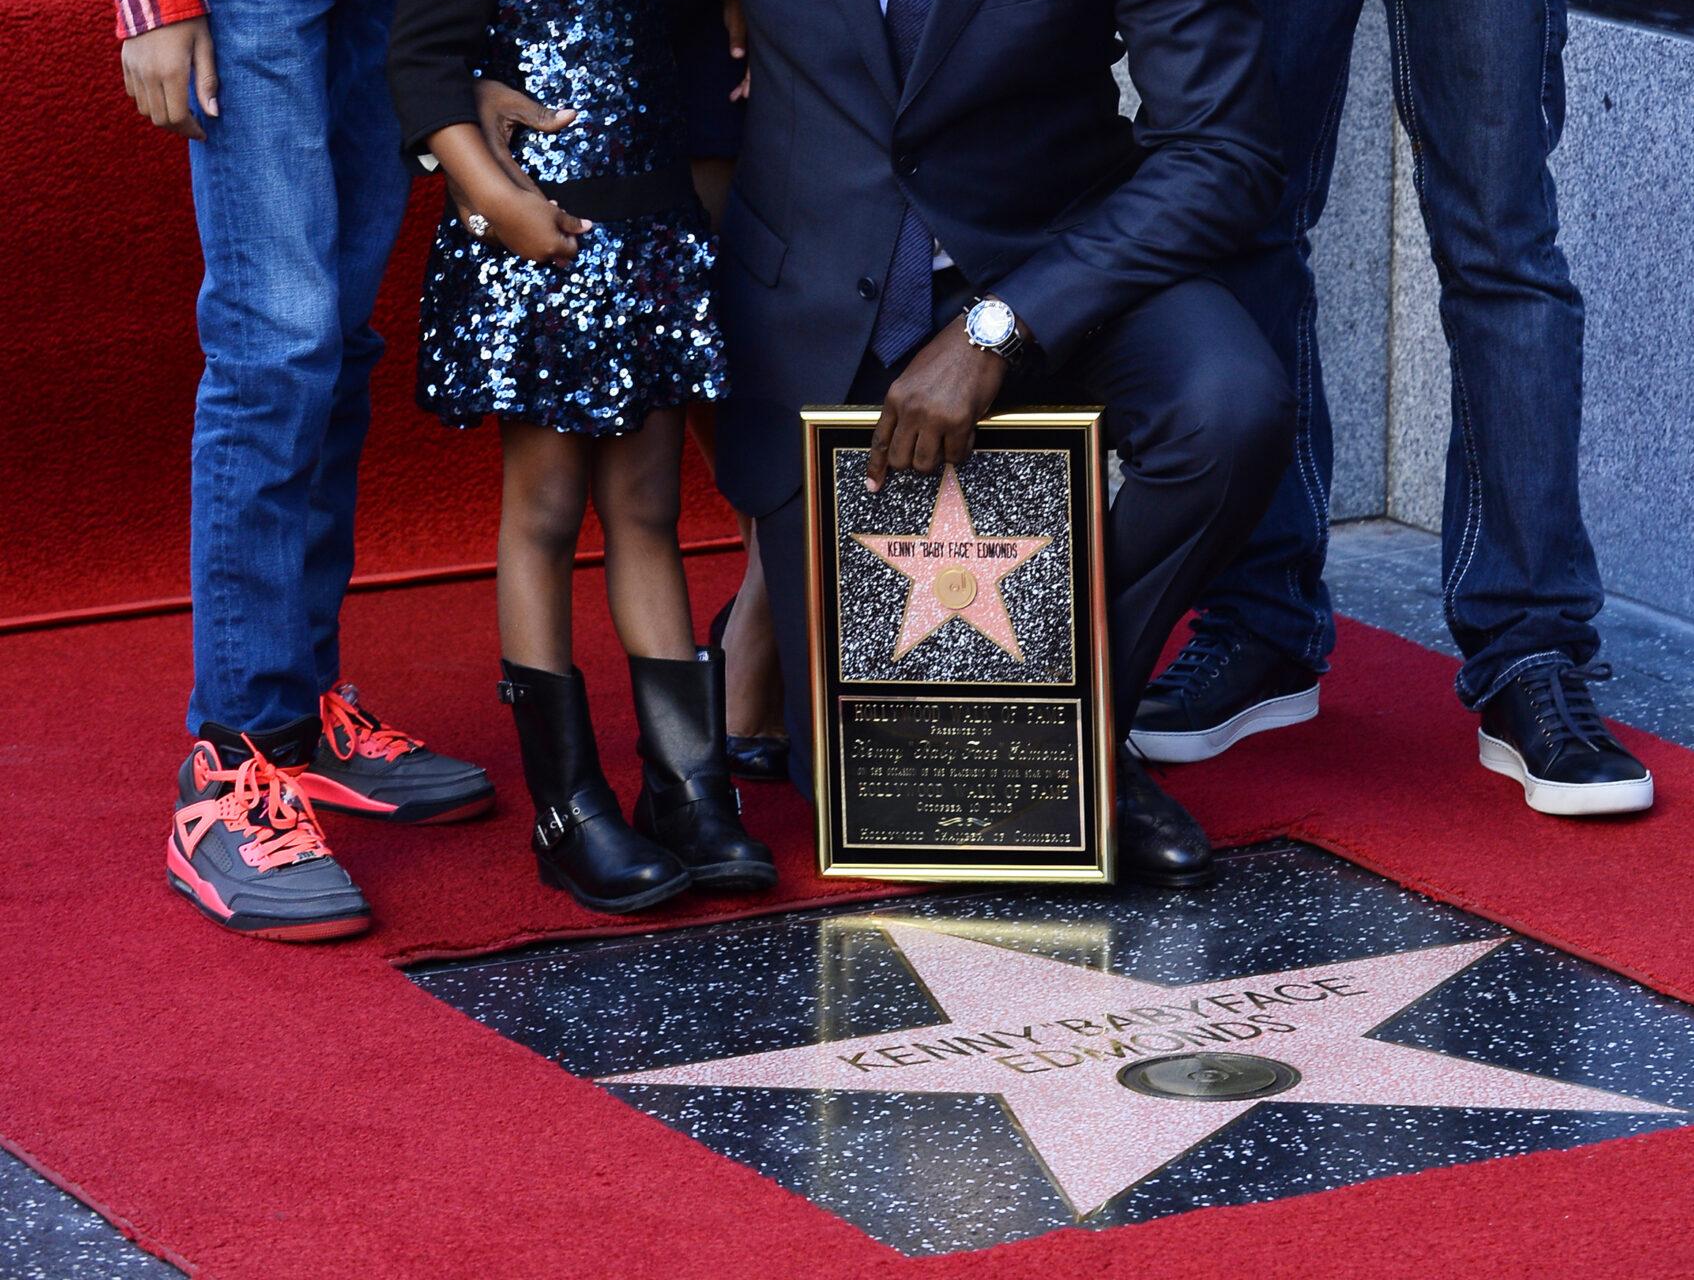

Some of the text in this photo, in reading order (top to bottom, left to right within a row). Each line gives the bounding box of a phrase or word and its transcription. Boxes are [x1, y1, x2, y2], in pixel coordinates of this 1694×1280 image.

[887, 541, 1018, 559] KENNY "BABY FACE" EDMONDS
[854, 704, 1067, 725] HOLLYWOOD WALK OF FAME
[858, 782, 1069, 800] HOLLYWOOD WALK OF FAME
[837, 1026, 1041, 1072] KENNY
[994, 1014, 1297, 1074] EDMONDS
